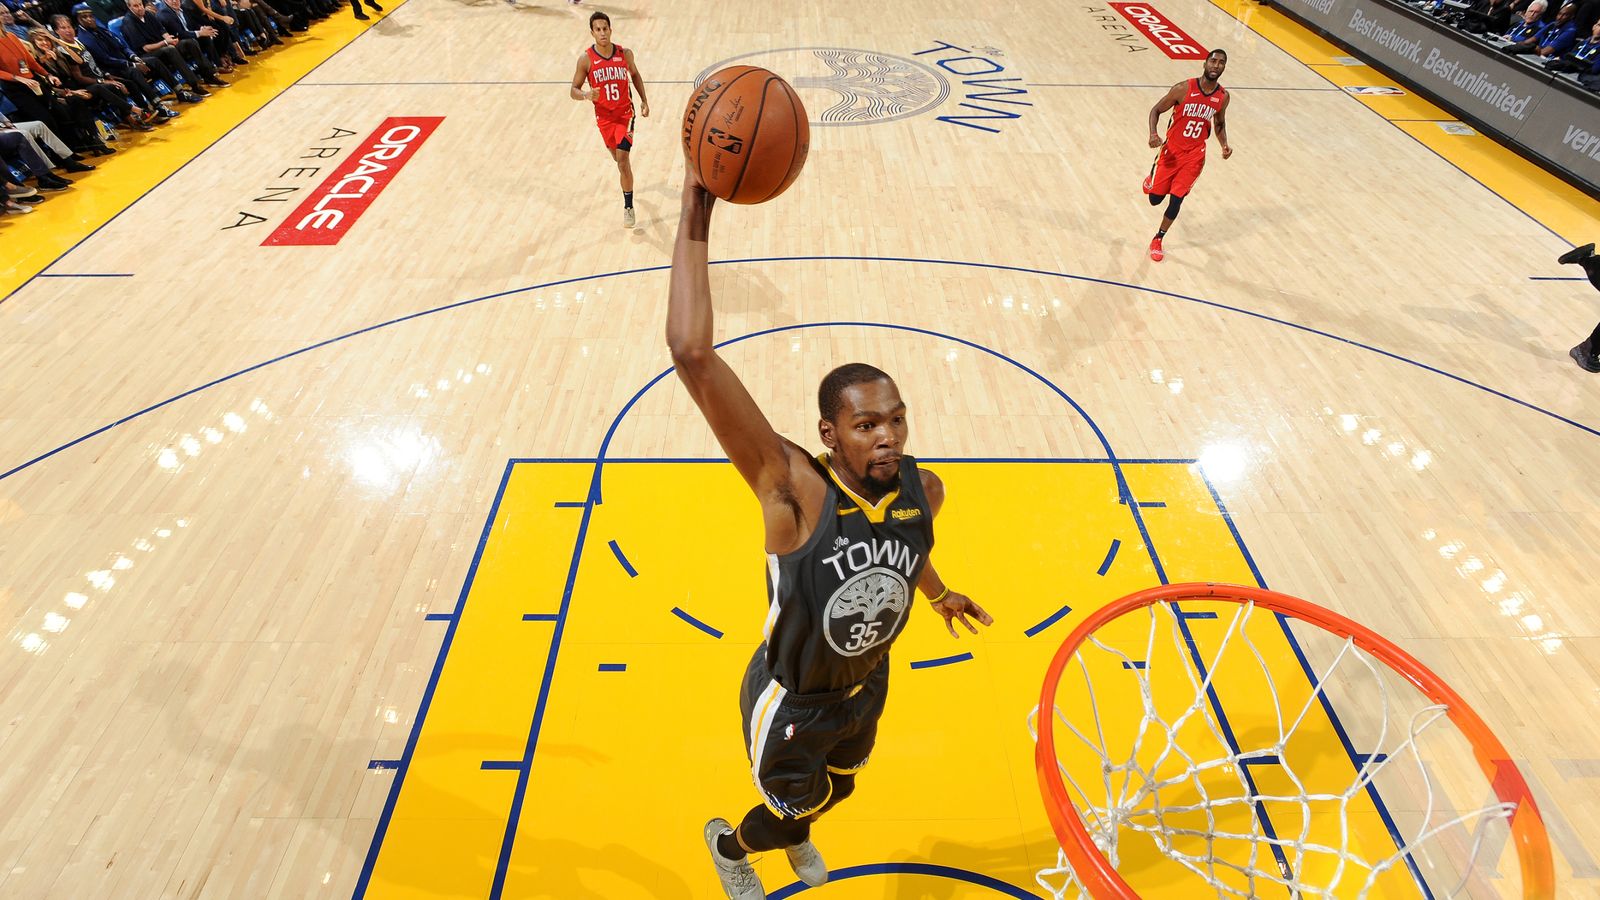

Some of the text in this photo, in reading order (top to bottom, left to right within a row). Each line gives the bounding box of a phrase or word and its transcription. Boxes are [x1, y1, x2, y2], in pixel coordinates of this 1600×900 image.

[1082, 6, 1149, 53] ARENA
[1124, 6, 1200, 54] ORACLE
[593, 66, 627, 83] PELICANS
[1348, 9, 1532, 120] Best network. Best unlimited.
[603, 83, 620, 101] 15
[911, 40, 1034, 133] TOWN
[1182, 103, 1217, 121] PELICAN
[1182, 120, 1205, 139] 55
[220, 127, 357, 230] ARENA
[295, 125, 421, 230] ORACLE
[891, 508, 921, 520] Rakuten
[822, 538, 919, 580] TOWN
[832, 535, 850, 551] The
[845, 621, 883, 651] 35
